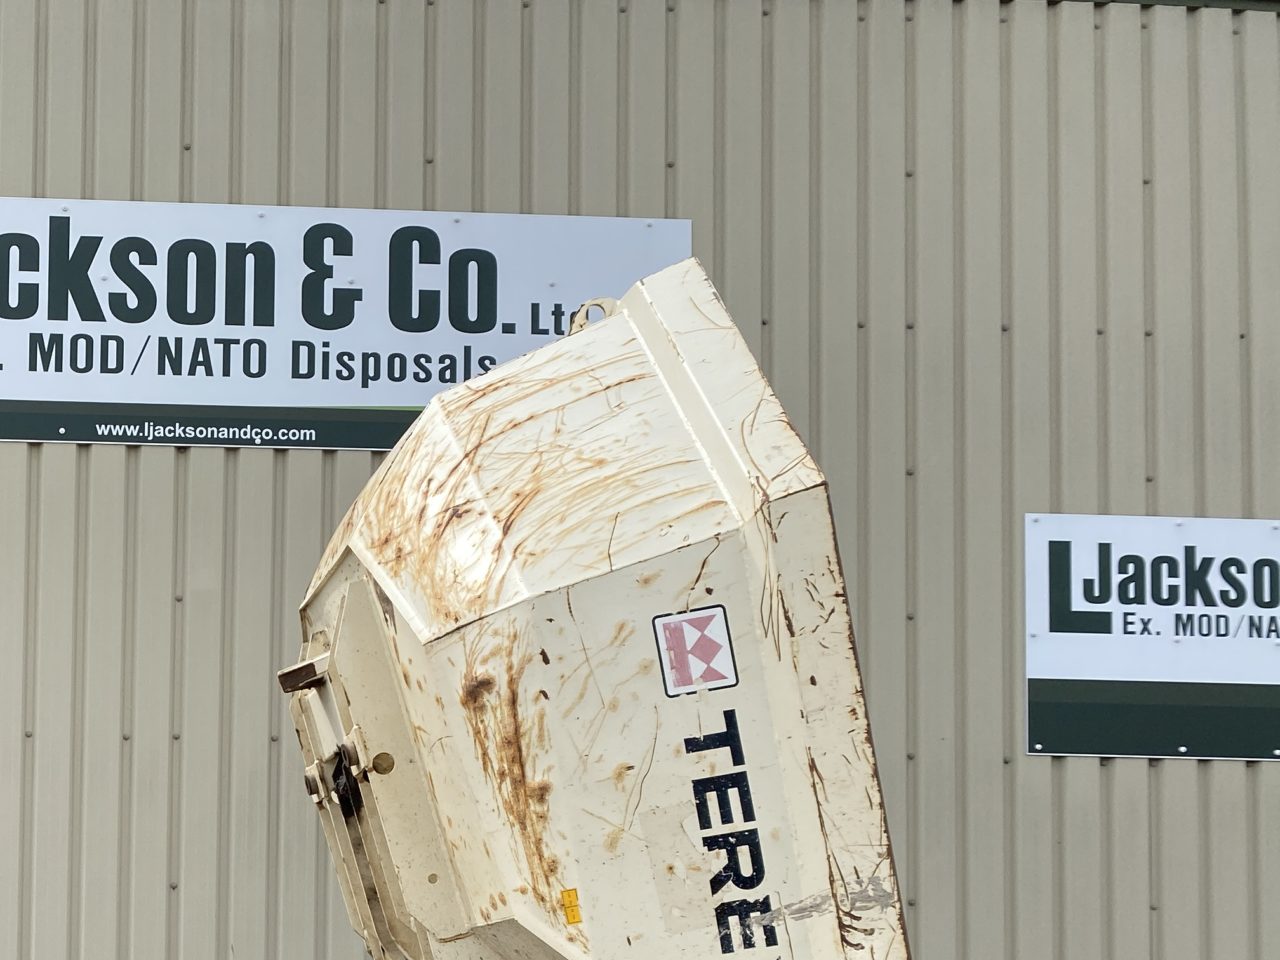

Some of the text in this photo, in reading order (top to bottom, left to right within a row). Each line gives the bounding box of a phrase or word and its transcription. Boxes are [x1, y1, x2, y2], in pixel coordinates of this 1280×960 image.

[301, 222, 363, 331] &
[388, 225, 516, 335] Co.
[530, 302, 589, 337] Lt
[28, 332, 267, 379] MOD/NATO
[291, 340, 497, 389] Disposals
[95, 421, 316, 441] www.ljacksonandco.com
[1123, 611, 1162, 636] Ex.
